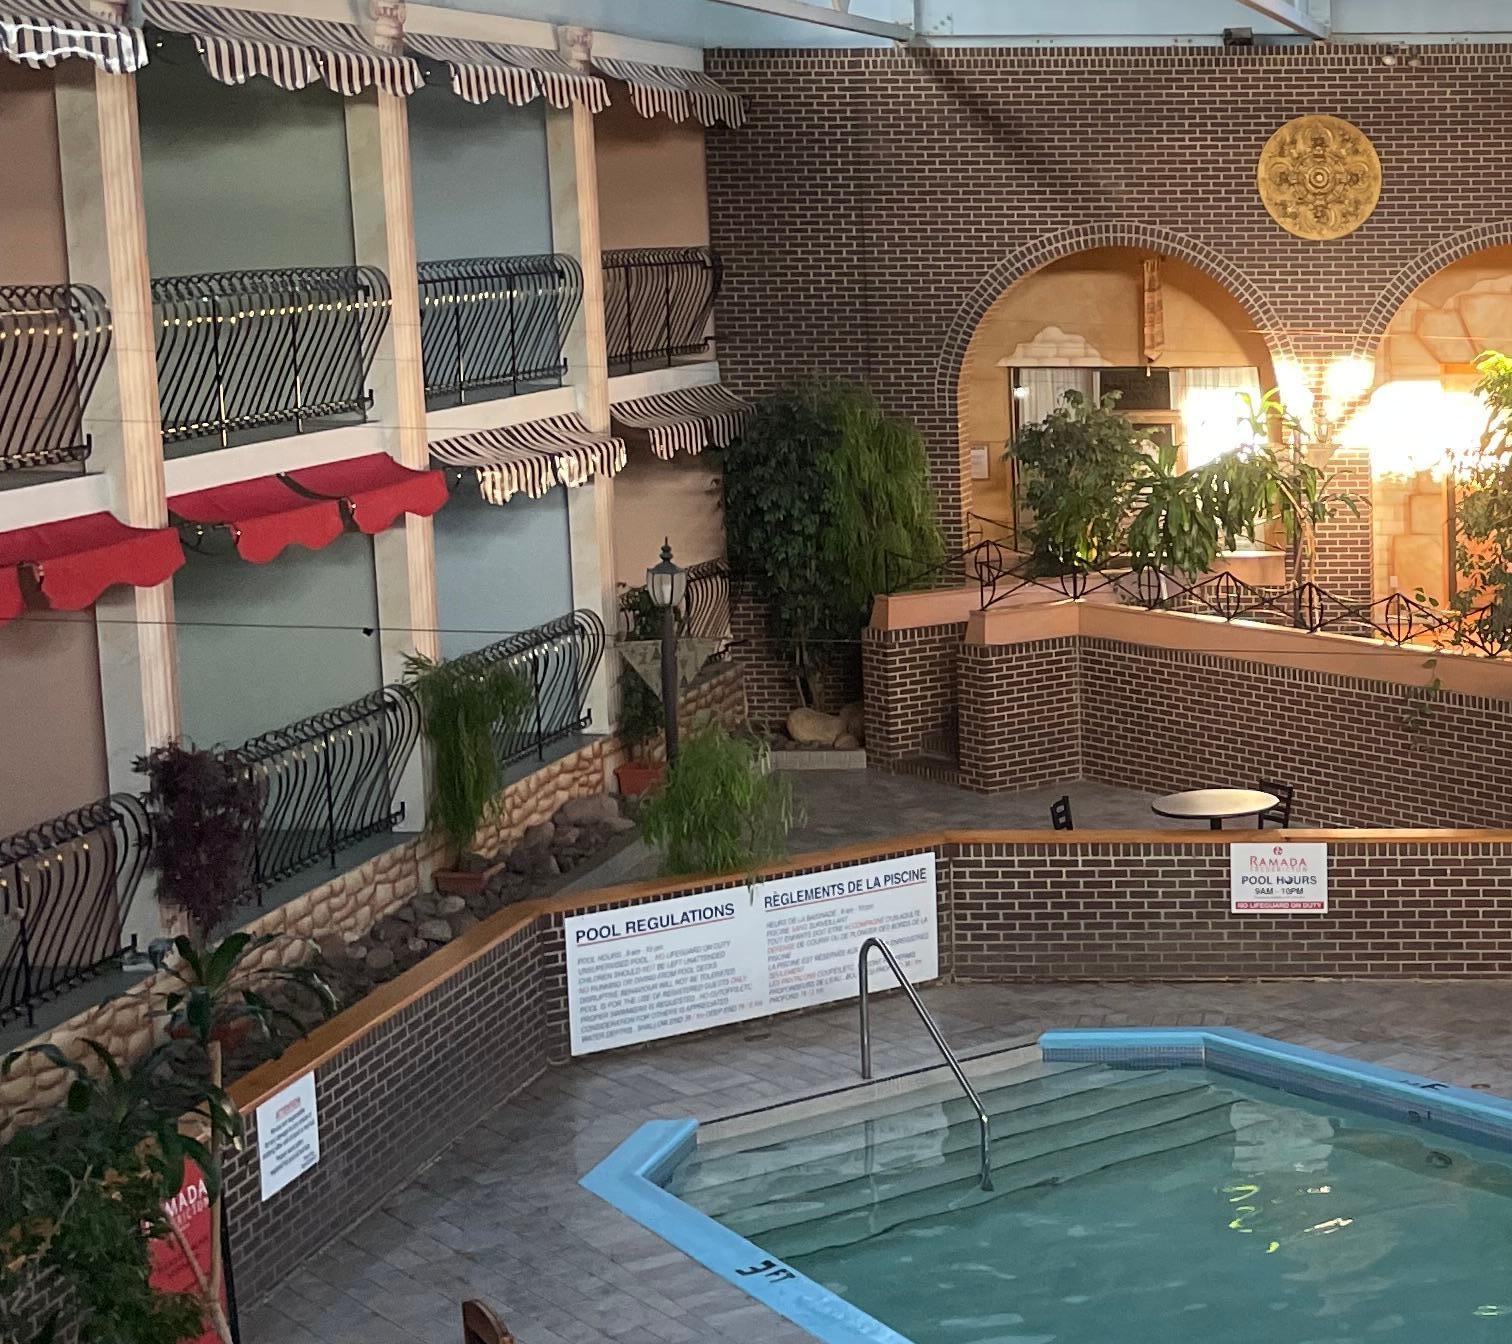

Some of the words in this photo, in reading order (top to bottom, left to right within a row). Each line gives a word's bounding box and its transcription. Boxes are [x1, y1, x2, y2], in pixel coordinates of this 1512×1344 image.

[1250, 856, 1307, 867] RAMADA
[764, 882, 845, 909] RÈGLEMENTS
[848, 879, 863, 894] DE
[866, 876, 881, 890] LA
[883, 868, 927, 886] PISCINE
[1241, 876, 1273, 885] POOL
[1277, 876, 1317, 885] HOURS
[575, 924, 621, 943] POOL
[625, 903, 735, 934] REGULATIONS
